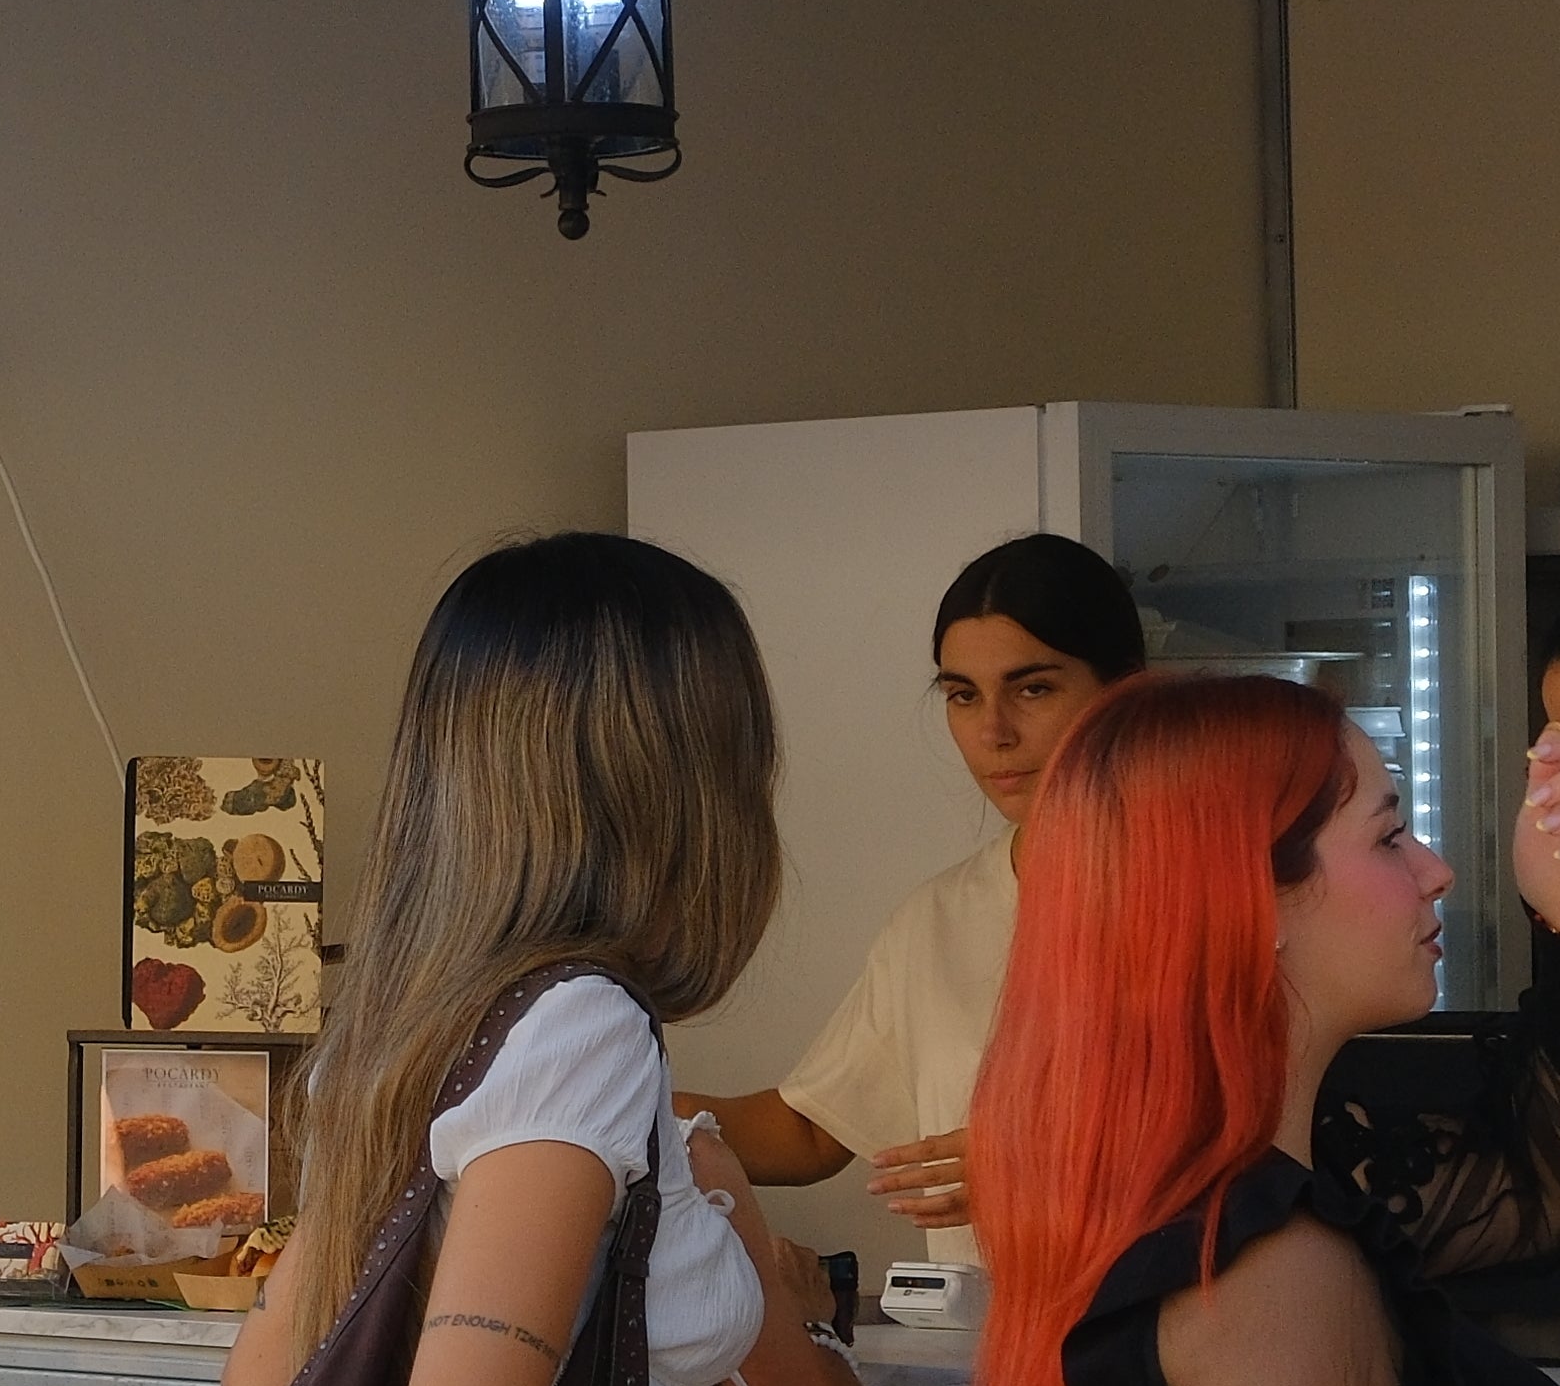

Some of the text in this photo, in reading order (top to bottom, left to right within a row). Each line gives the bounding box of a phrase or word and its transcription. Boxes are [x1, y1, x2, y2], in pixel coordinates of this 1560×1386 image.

[257, 884, 308, 894] POCARDY
[145, 1067, 221, 1080] POCARDY
[451, 1313, 512, 1336] ENOUGH
